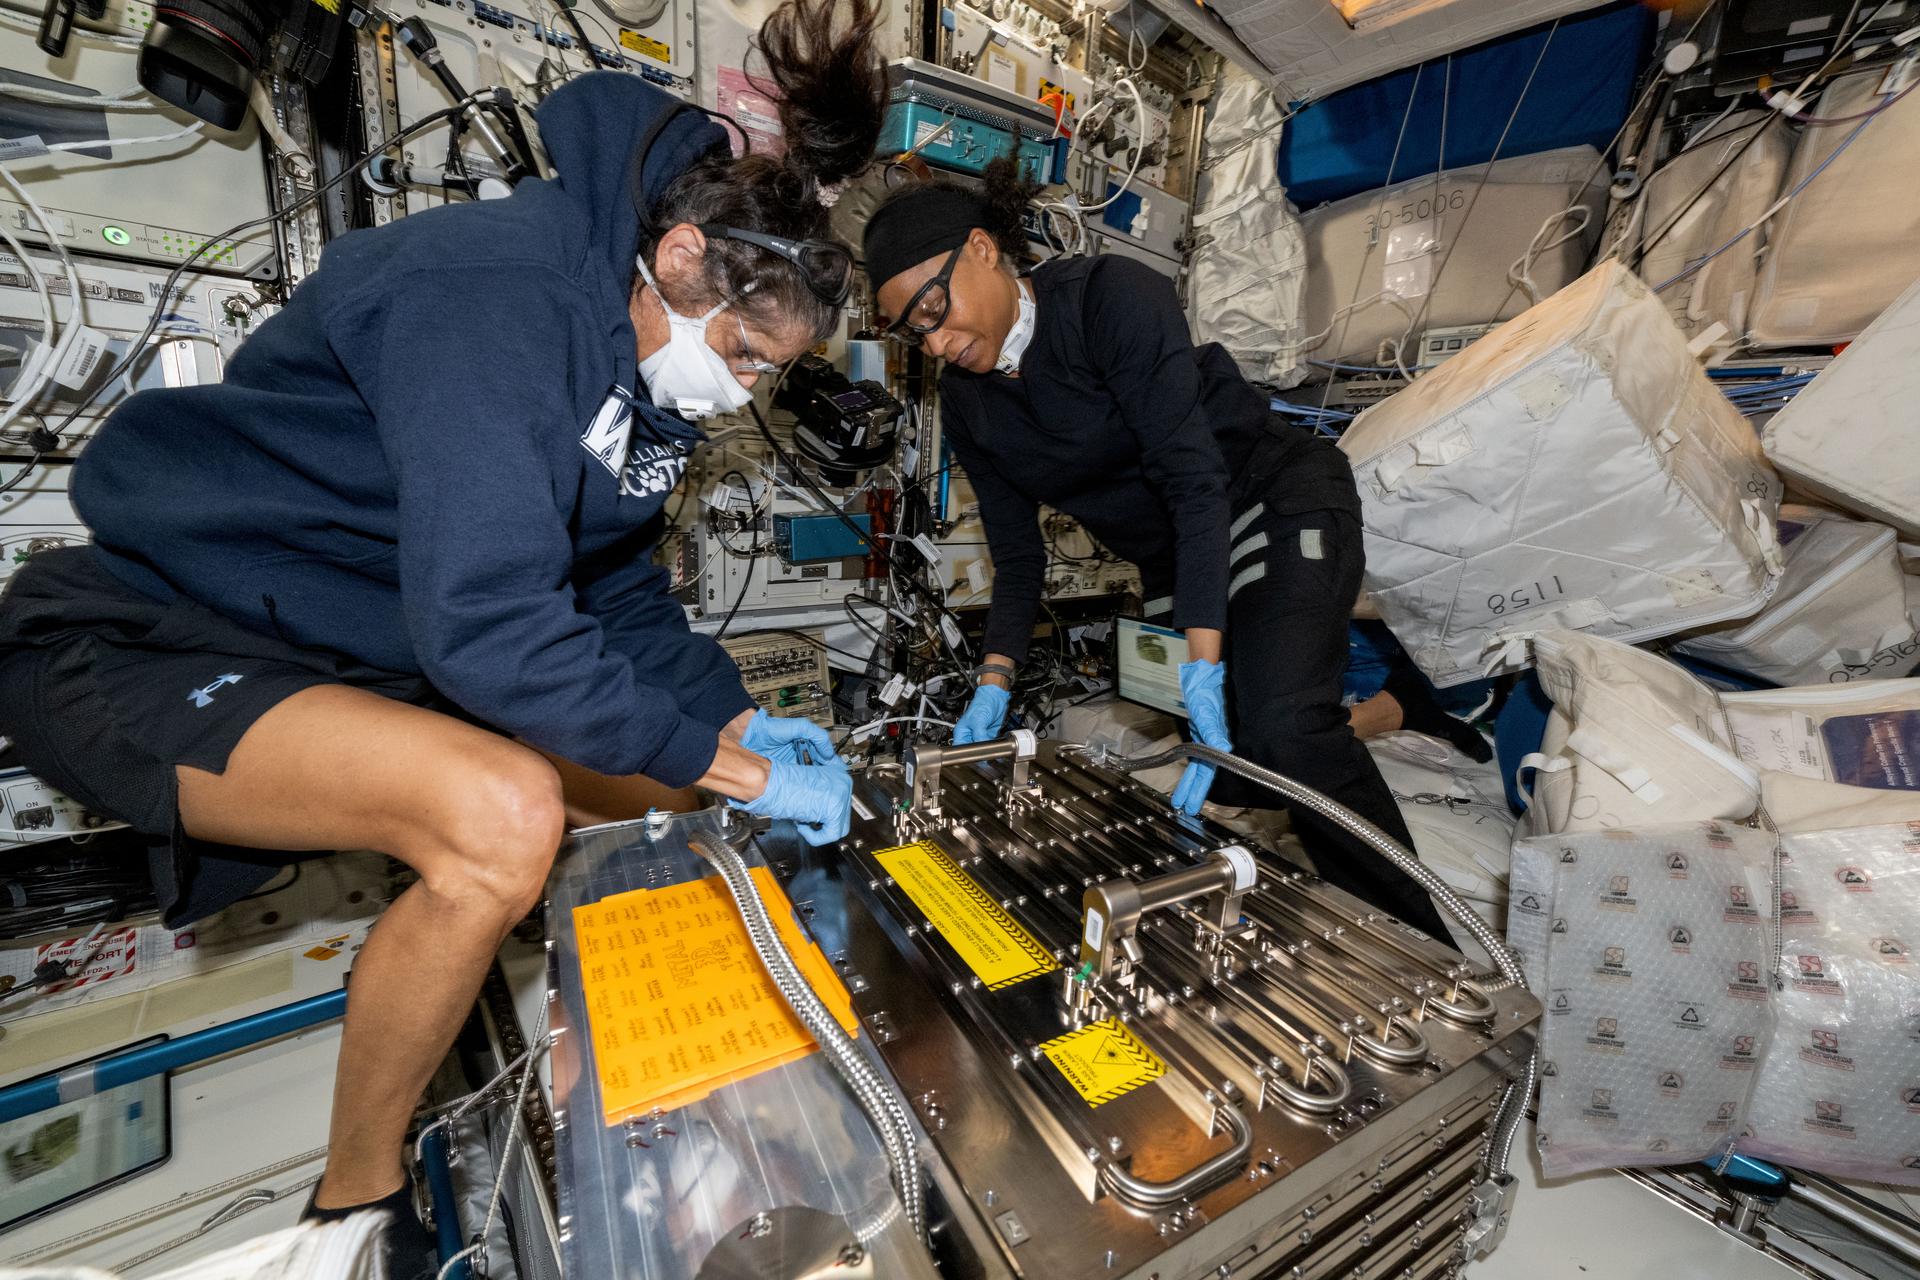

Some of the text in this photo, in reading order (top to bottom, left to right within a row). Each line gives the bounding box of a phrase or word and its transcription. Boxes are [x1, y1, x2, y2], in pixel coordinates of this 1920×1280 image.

[1487, 575, 1564, 615] 1158
[660, 938, 698, 991] METAL
[1051, 1053, 1089, 1092] WARNING
